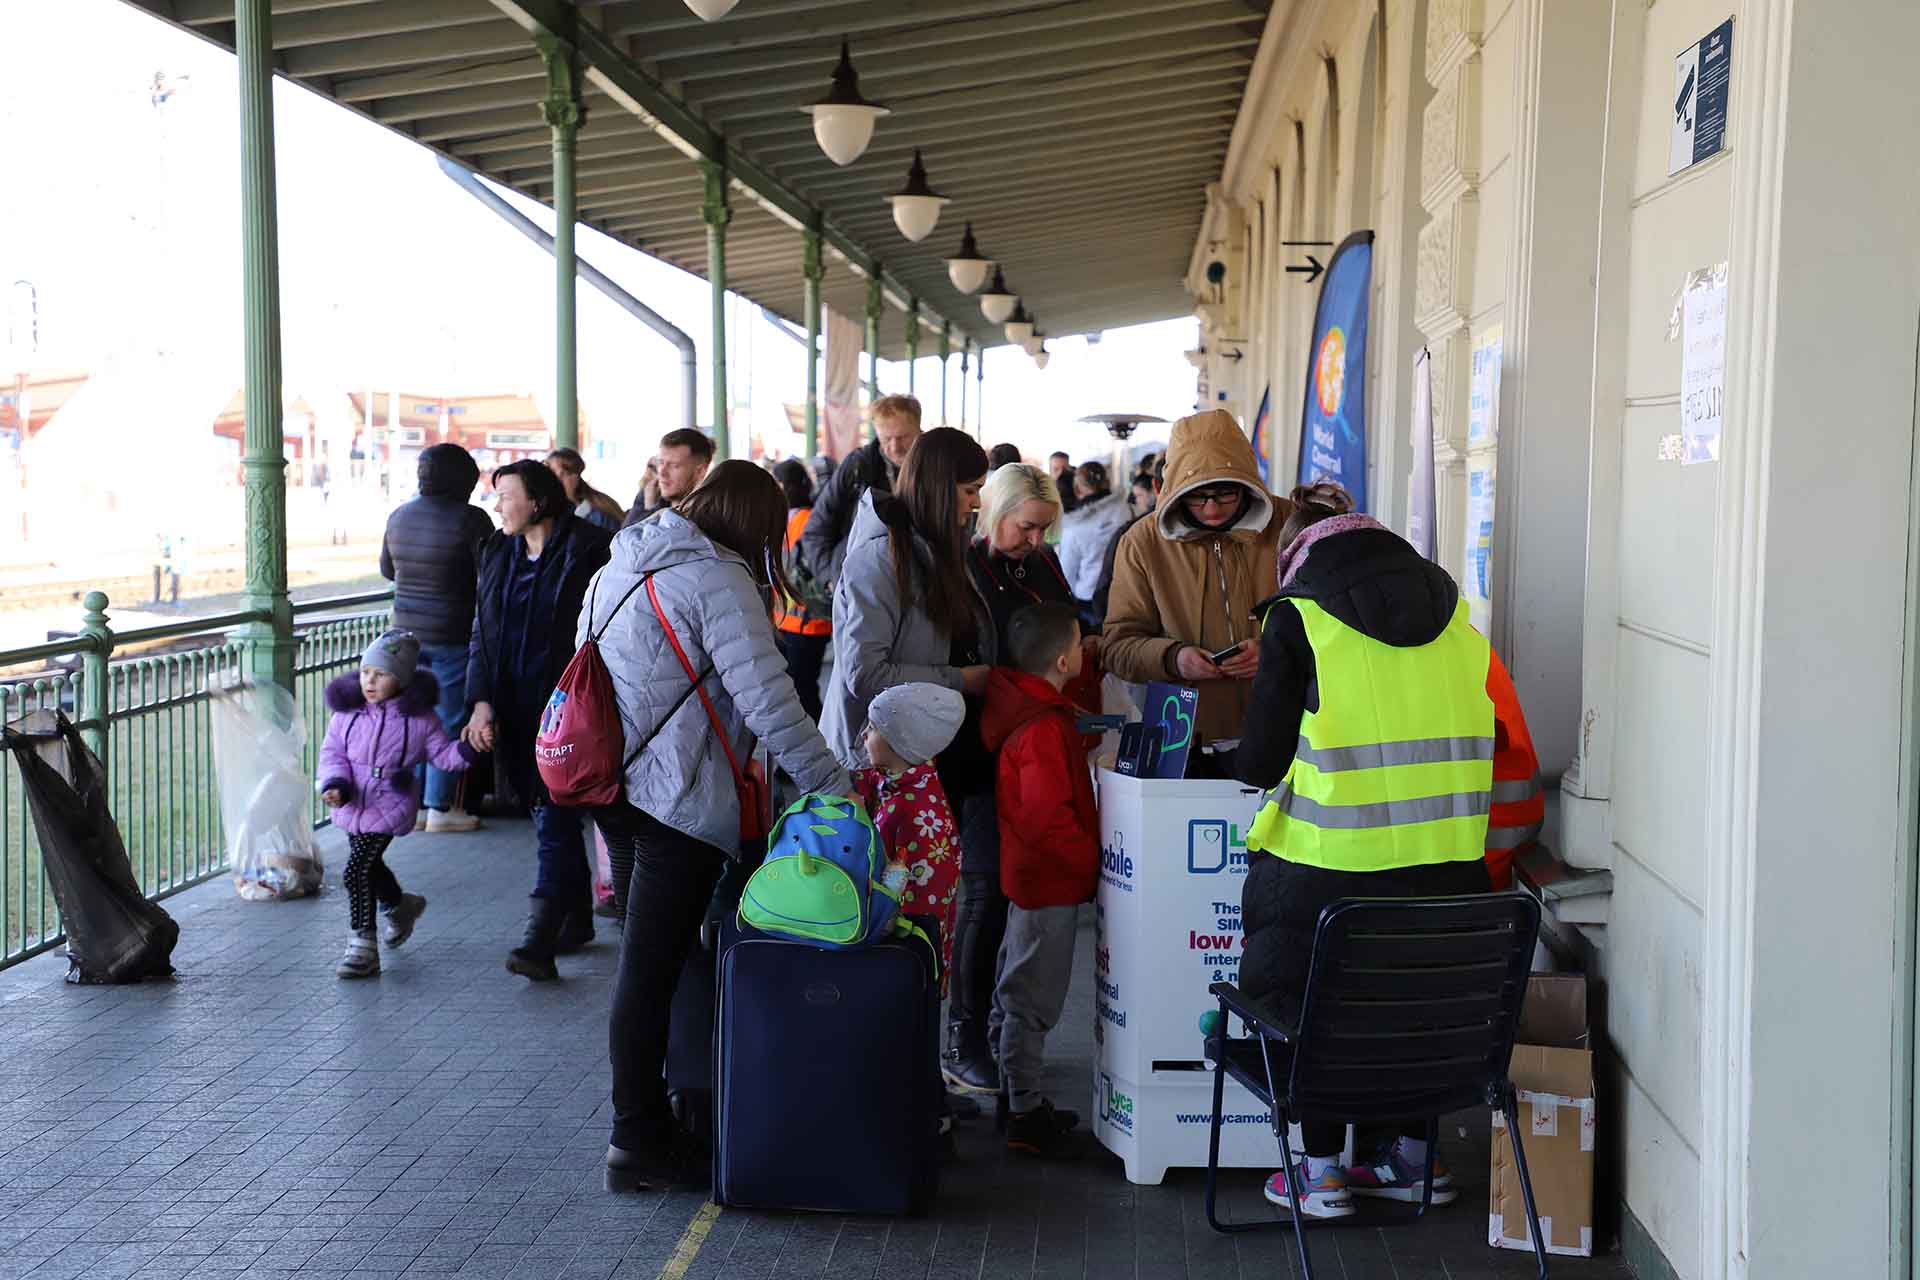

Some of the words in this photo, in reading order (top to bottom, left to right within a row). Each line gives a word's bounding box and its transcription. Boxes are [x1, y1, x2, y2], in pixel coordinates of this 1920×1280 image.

[1230, 824, 1247, 847] L
[1102, 843, 1133, 878] obile
[1230, 852, 1248, 865] m
[1212, 902, 1241, 914] The
[1190, 930, 1233, 950] low
[1204, 953, 1241, 966] inter
[1212, 969, 1224, 982] &
[1228, 972, 1238, 982] n
[1111, 1082, 1133, 1114] Lyca
[1110, 1106, 1133, 1129] mobile
